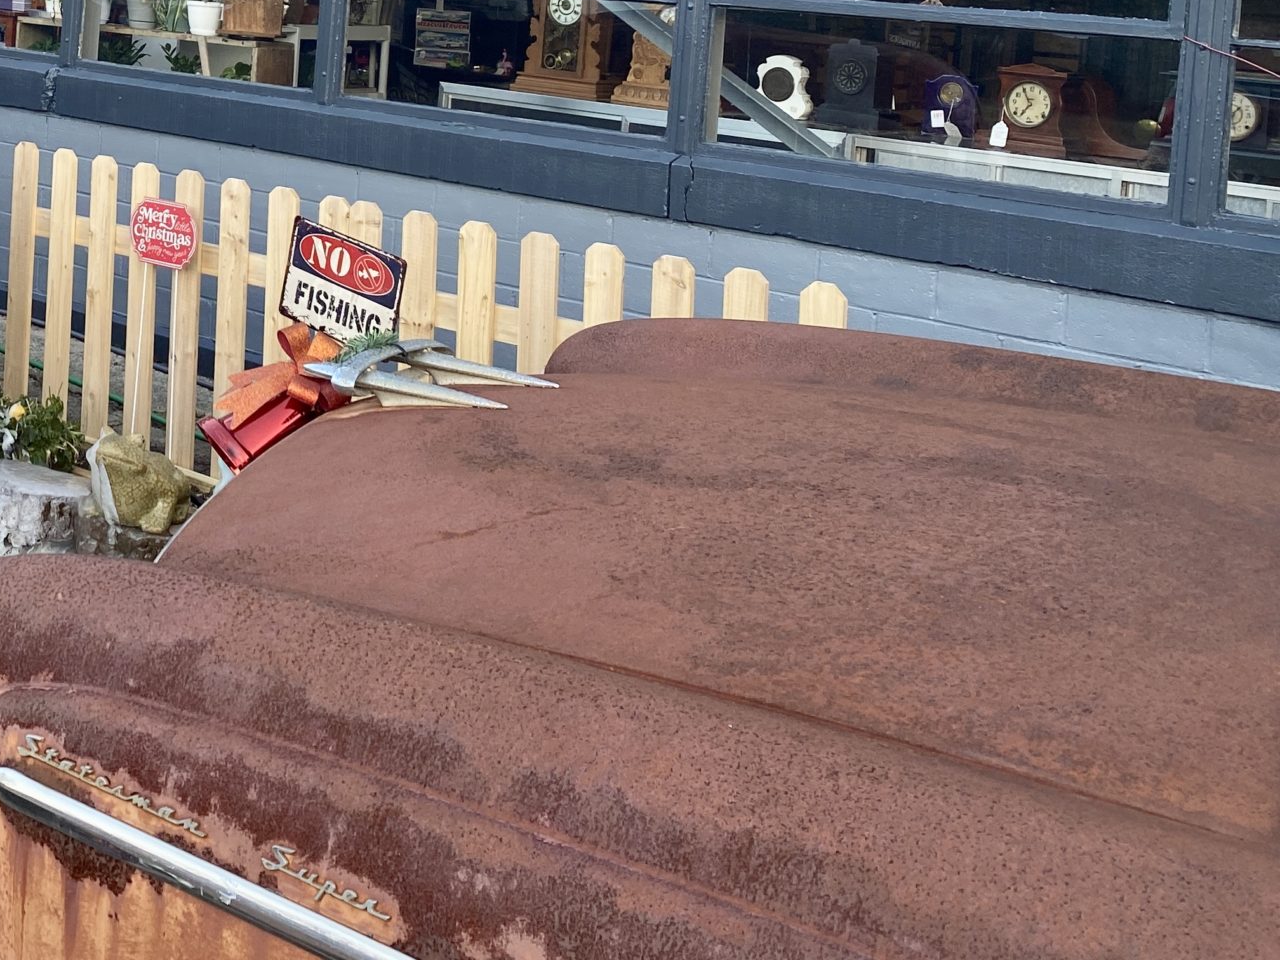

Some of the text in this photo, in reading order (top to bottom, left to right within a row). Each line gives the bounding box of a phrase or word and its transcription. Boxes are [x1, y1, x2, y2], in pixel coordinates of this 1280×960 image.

[137, 206, 178, 230] Merry
[134, 223, 192, 250] Christmas
[137, 238, 147, 252] &
[308, 235, 351, 277] NO
[294, 279, 382, 334] FISHING
[18, 733, 392, 921] Statesman Super
